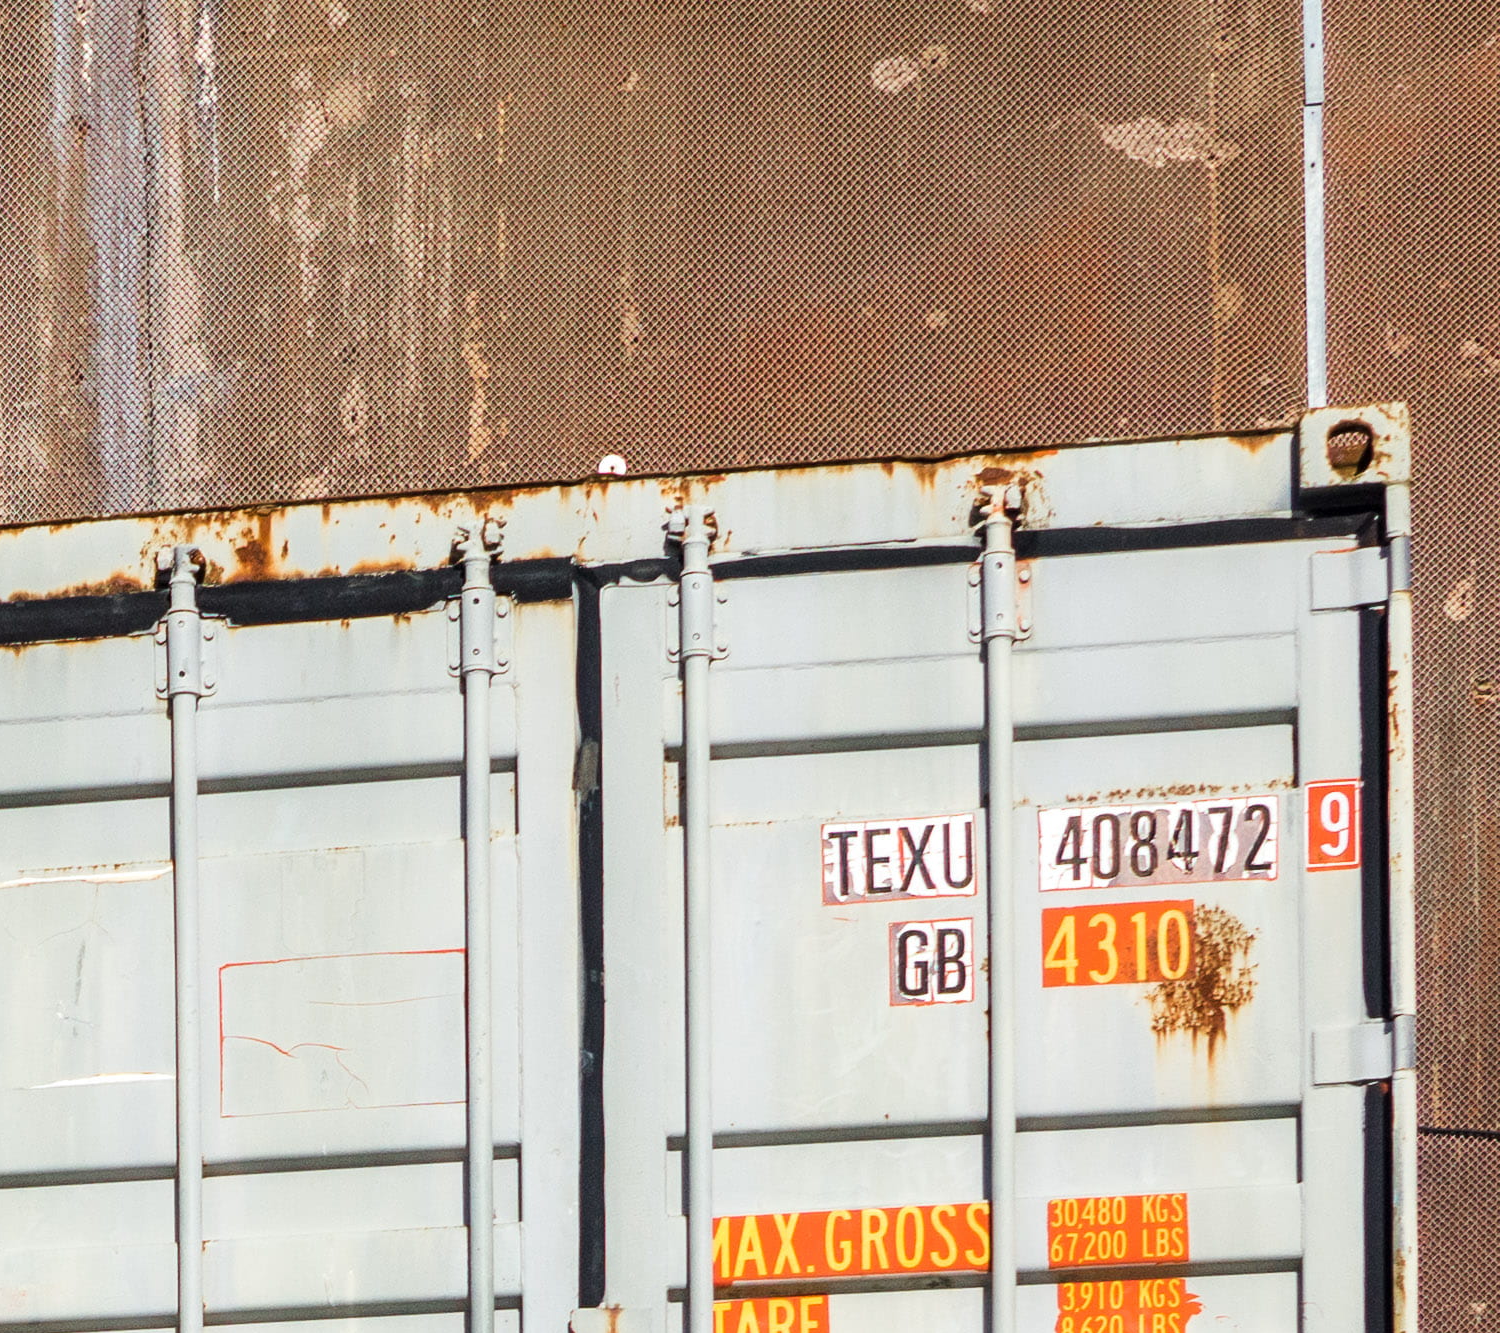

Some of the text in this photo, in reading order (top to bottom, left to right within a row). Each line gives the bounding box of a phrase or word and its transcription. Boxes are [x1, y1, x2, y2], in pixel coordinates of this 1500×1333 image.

[827, 791, 1350, 897] TEXU 408472 9
[898, 909, 1191, 998] GB 4310
[1050, 1193, 1184, 1229] 30,480 KGS
[1050, 1227, 1184, 1264] 67,200 LBS
[1062, 1278, 1181, 1312] 3,910 KGS
